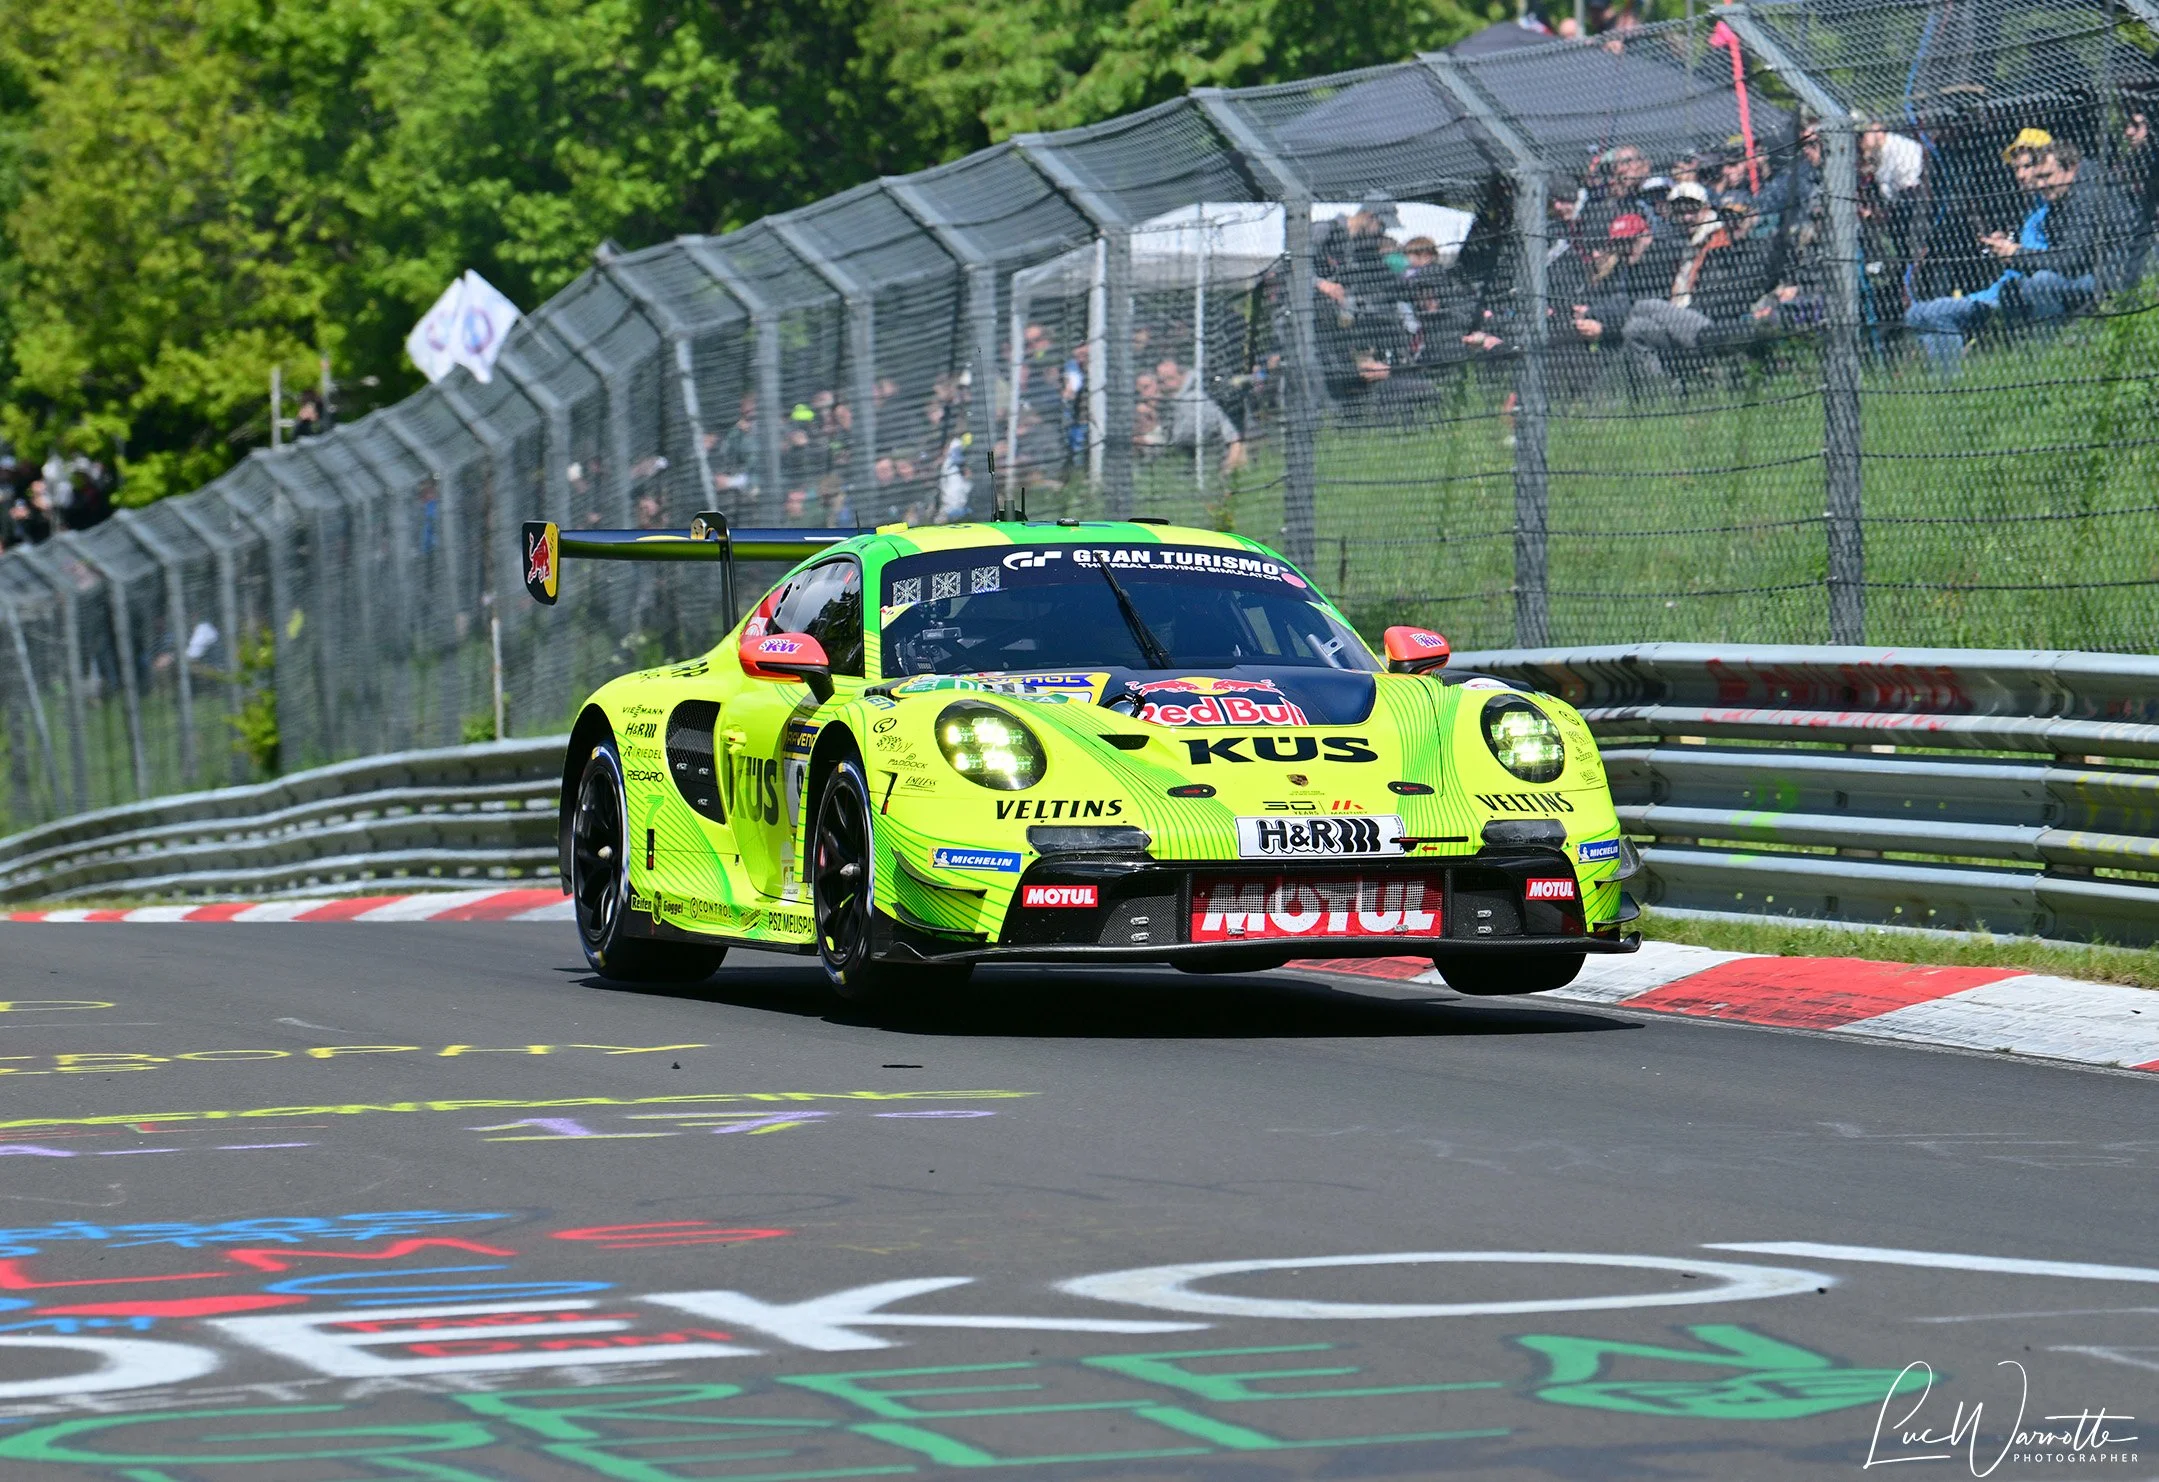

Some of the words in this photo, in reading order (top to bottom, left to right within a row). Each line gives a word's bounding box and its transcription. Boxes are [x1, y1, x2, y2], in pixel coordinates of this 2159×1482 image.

[1072, 549, 1151, 563] GRAN
[1159, 551, 1279, 575] TURISMO
[1148, 563, 1206, 572] DRIVING
[1207, 566, 1283, 582] SIMULATOR
[1220, 696, 1310, 727] Bull
[636, 747, 662, 760] RIEDEL
[1179, 736, 1379, 765] KÜS
[626, 769, 665, 783] RECARO
[727, 753, 779, 827] KÜS
[996, 800, 1123, 820] VELTINS
[1474, 791, 1575, 813] VELTINS
[1257, 819, 1341, 854] H&R
[949, 853, 1015, 868] MICHELIN
[1589, 846, 1619, 858] MICHELIN
[1025, 888, 1095, 906] MOTUL
[1528, 881, 1575, 898] MOTUL
[632, 896, 652, 910] Reifen
[698, 900, 732, 918] CONTROL
[1202, 878, 1437, 933] MOTUL
[0, 1241, 2159, 1399] EKO
[0, 1324, 1832, 1464] GREEN
